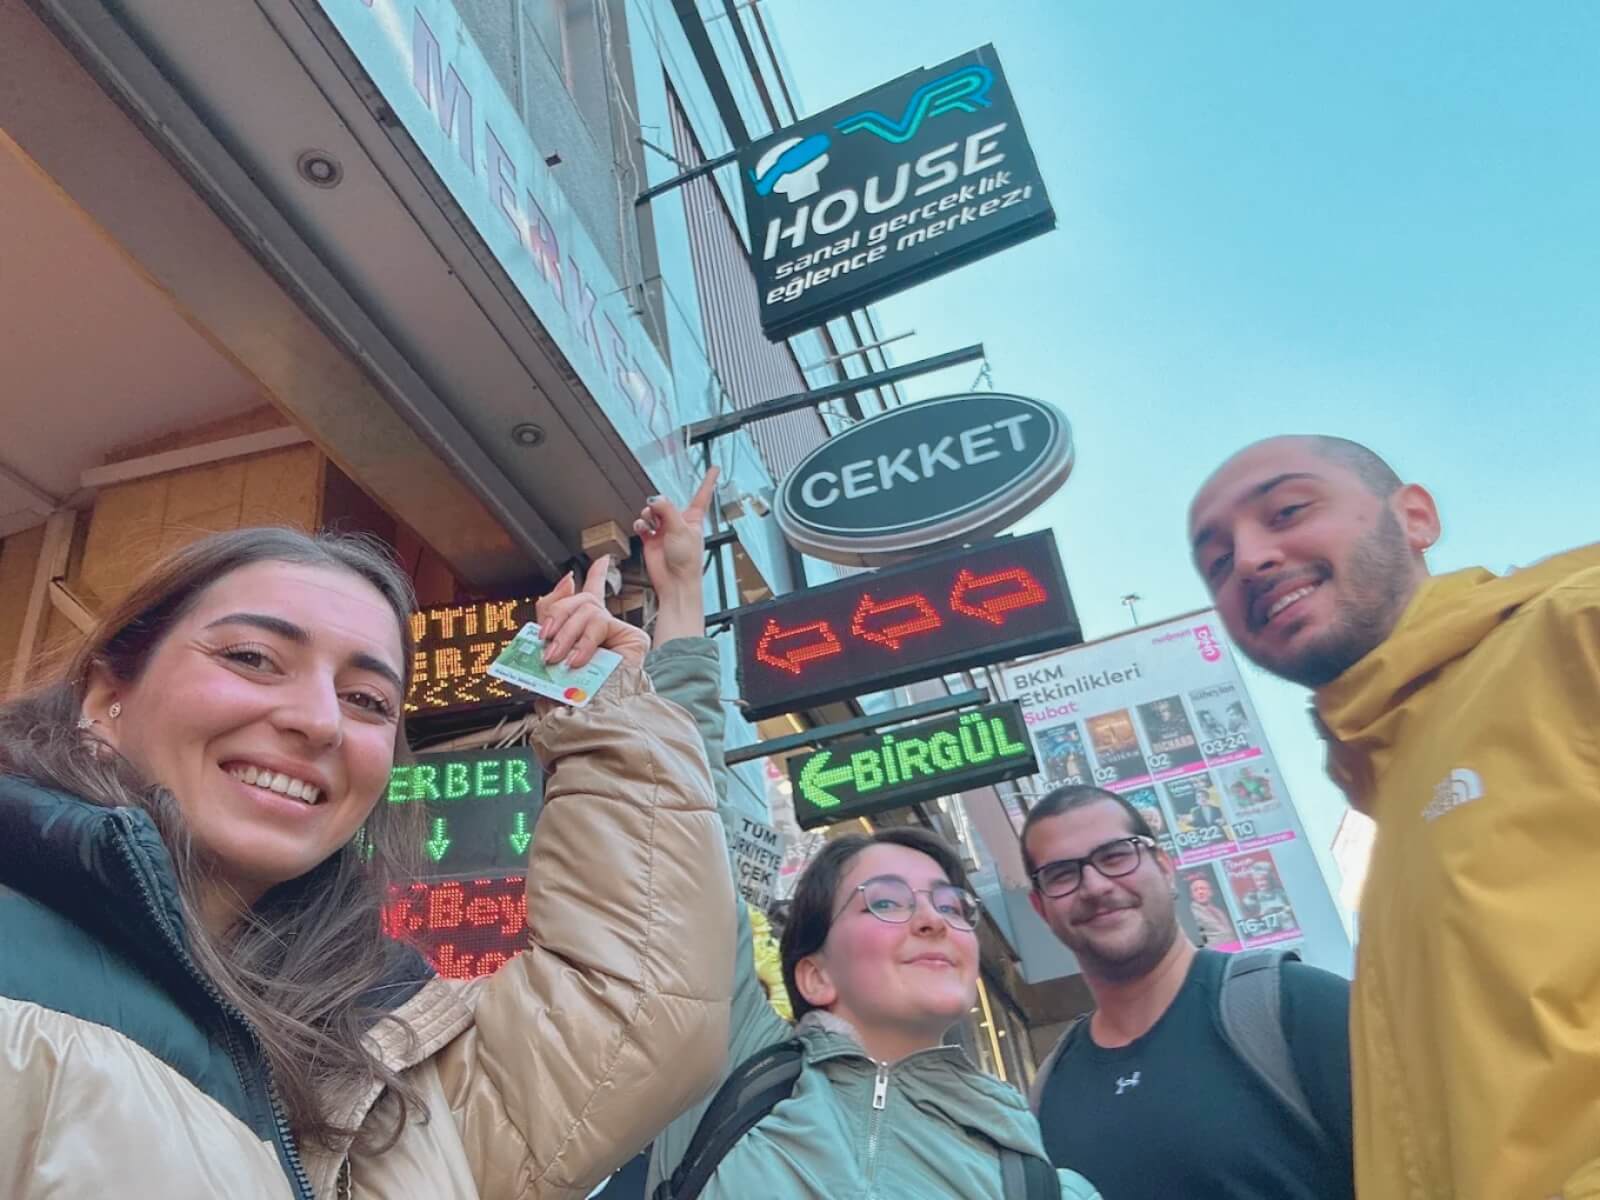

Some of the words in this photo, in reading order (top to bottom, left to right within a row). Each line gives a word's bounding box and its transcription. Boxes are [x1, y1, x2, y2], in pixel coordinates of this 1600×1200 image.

[763, 121, 1008, 261] HOUSE
[775, 230, 860, 280] sanal
[801, 413, 1033, 509] CEKKET
[1013, 664, 1065, 690] BKM
[1020, 663, 1142, 708] Etkinlikleri
[850, 711, 1026, 793] BİRGÜL
[1095, 766, 1116, 781] 02
[1149, 753, 1169, 768] 02
[388, 760, 532, 801] ERBER
